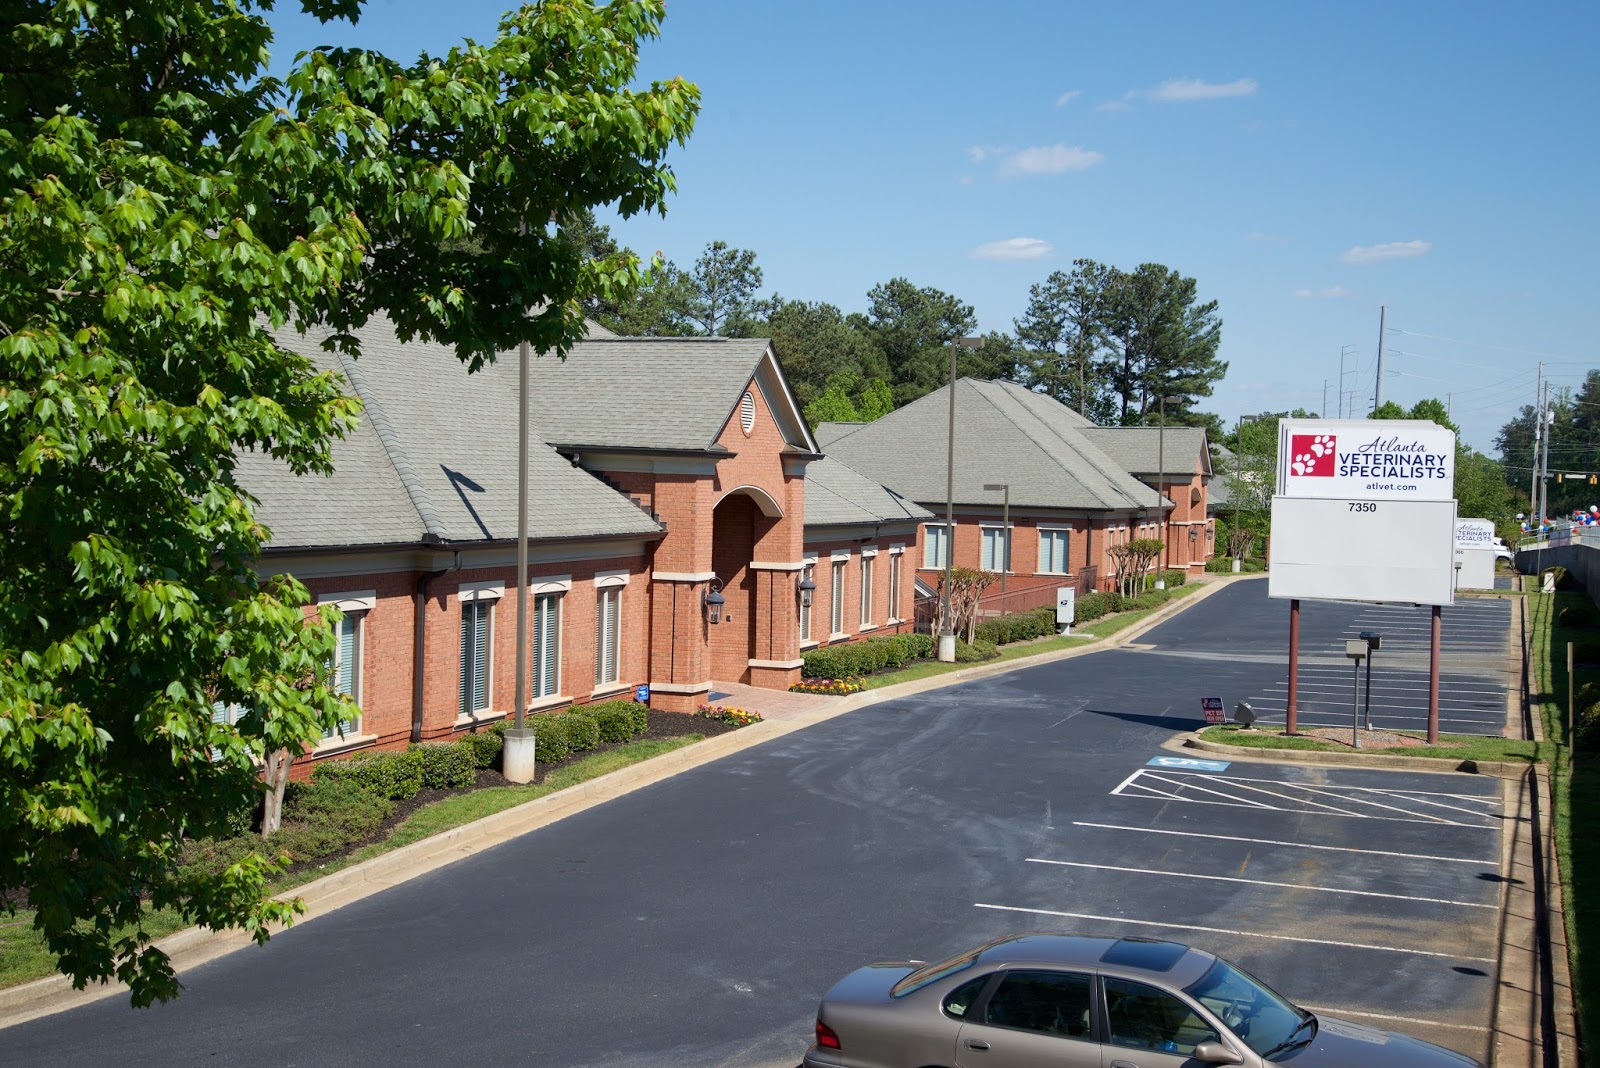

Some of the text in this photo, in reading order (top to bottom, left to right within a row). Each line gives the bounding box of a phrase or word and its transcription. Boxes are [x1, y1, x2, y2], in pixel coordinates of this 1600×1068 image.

[1358, 436, 1427, 453] Atlanta
[1339, 453, 1447, 466] VETERINARY
[1339, 465, 1446, 479] SPECIALISTS
[1366, 481, 1417, 491] atlvet.com
[1348, 502, 1377, 512] 7350
